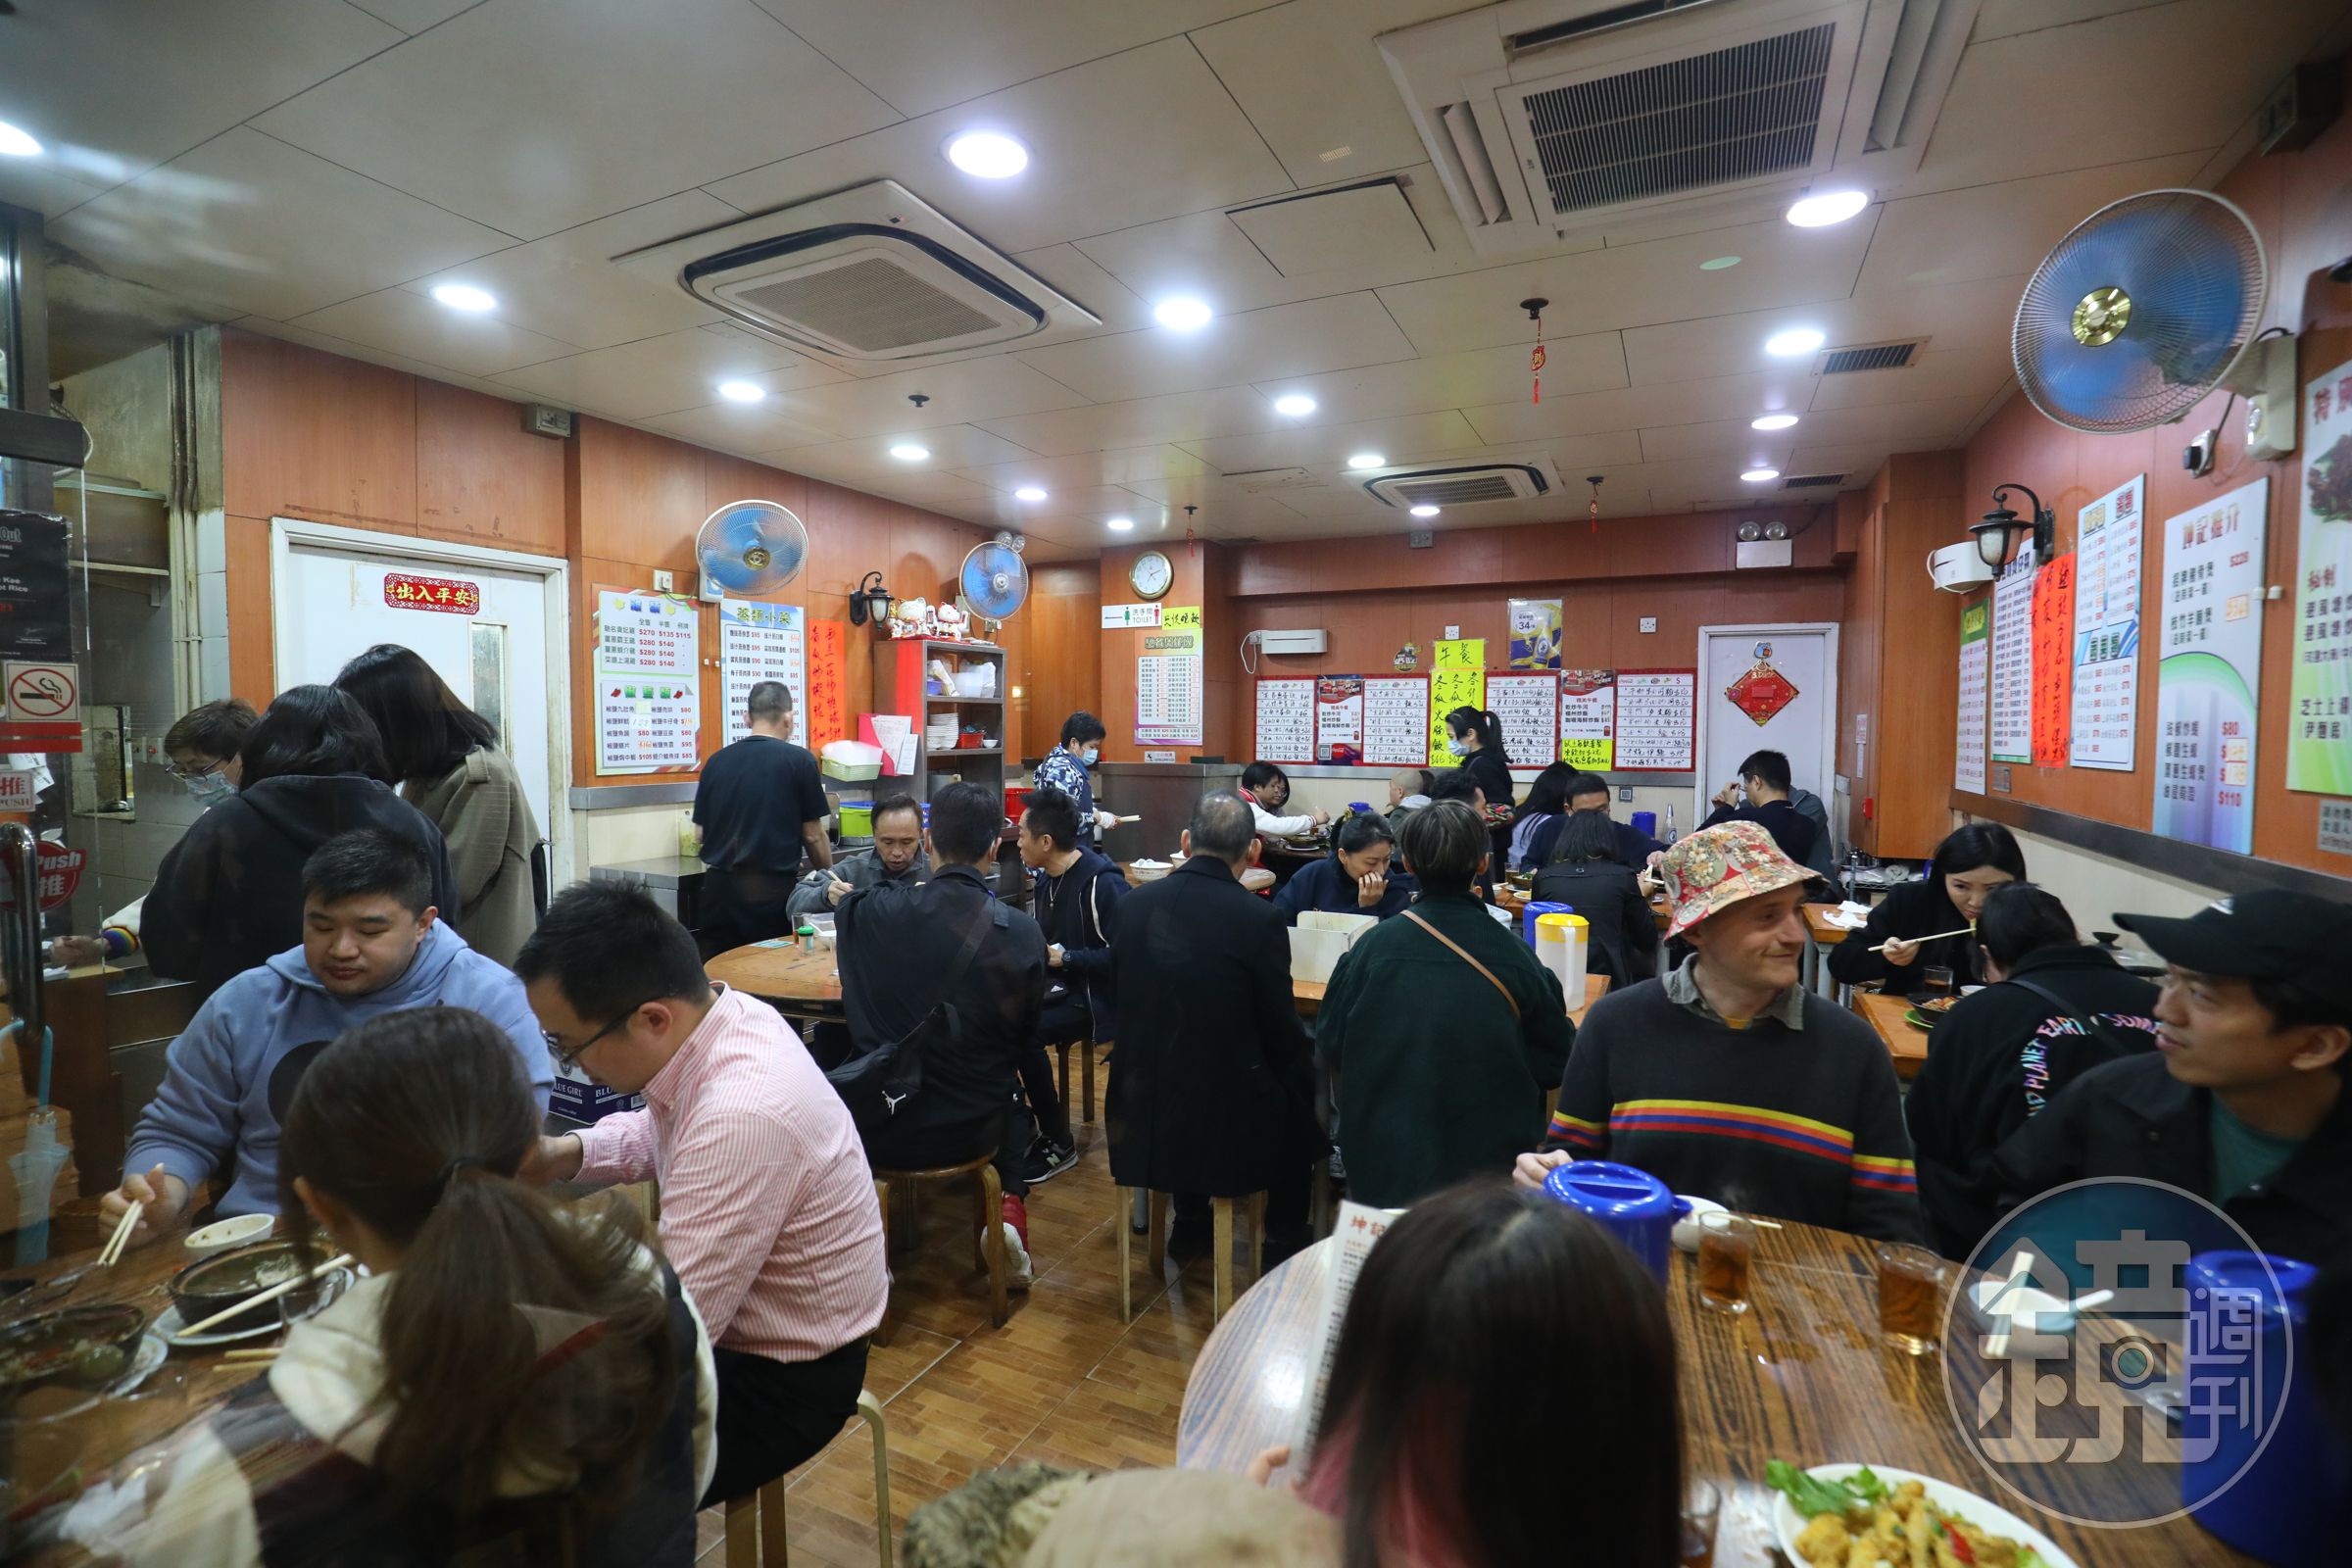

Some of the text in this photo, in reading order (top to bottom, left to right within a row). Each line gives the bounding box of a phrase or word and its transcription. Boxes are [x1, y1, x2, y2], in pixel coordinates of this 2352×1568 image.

[396, 582, 470, 606] 出入平安
[1440, 642, 1473, 667] 午餐
[2020, 1037, 2050, 1090] PLANET
[566, 1086, 583, 1098] GIRL
